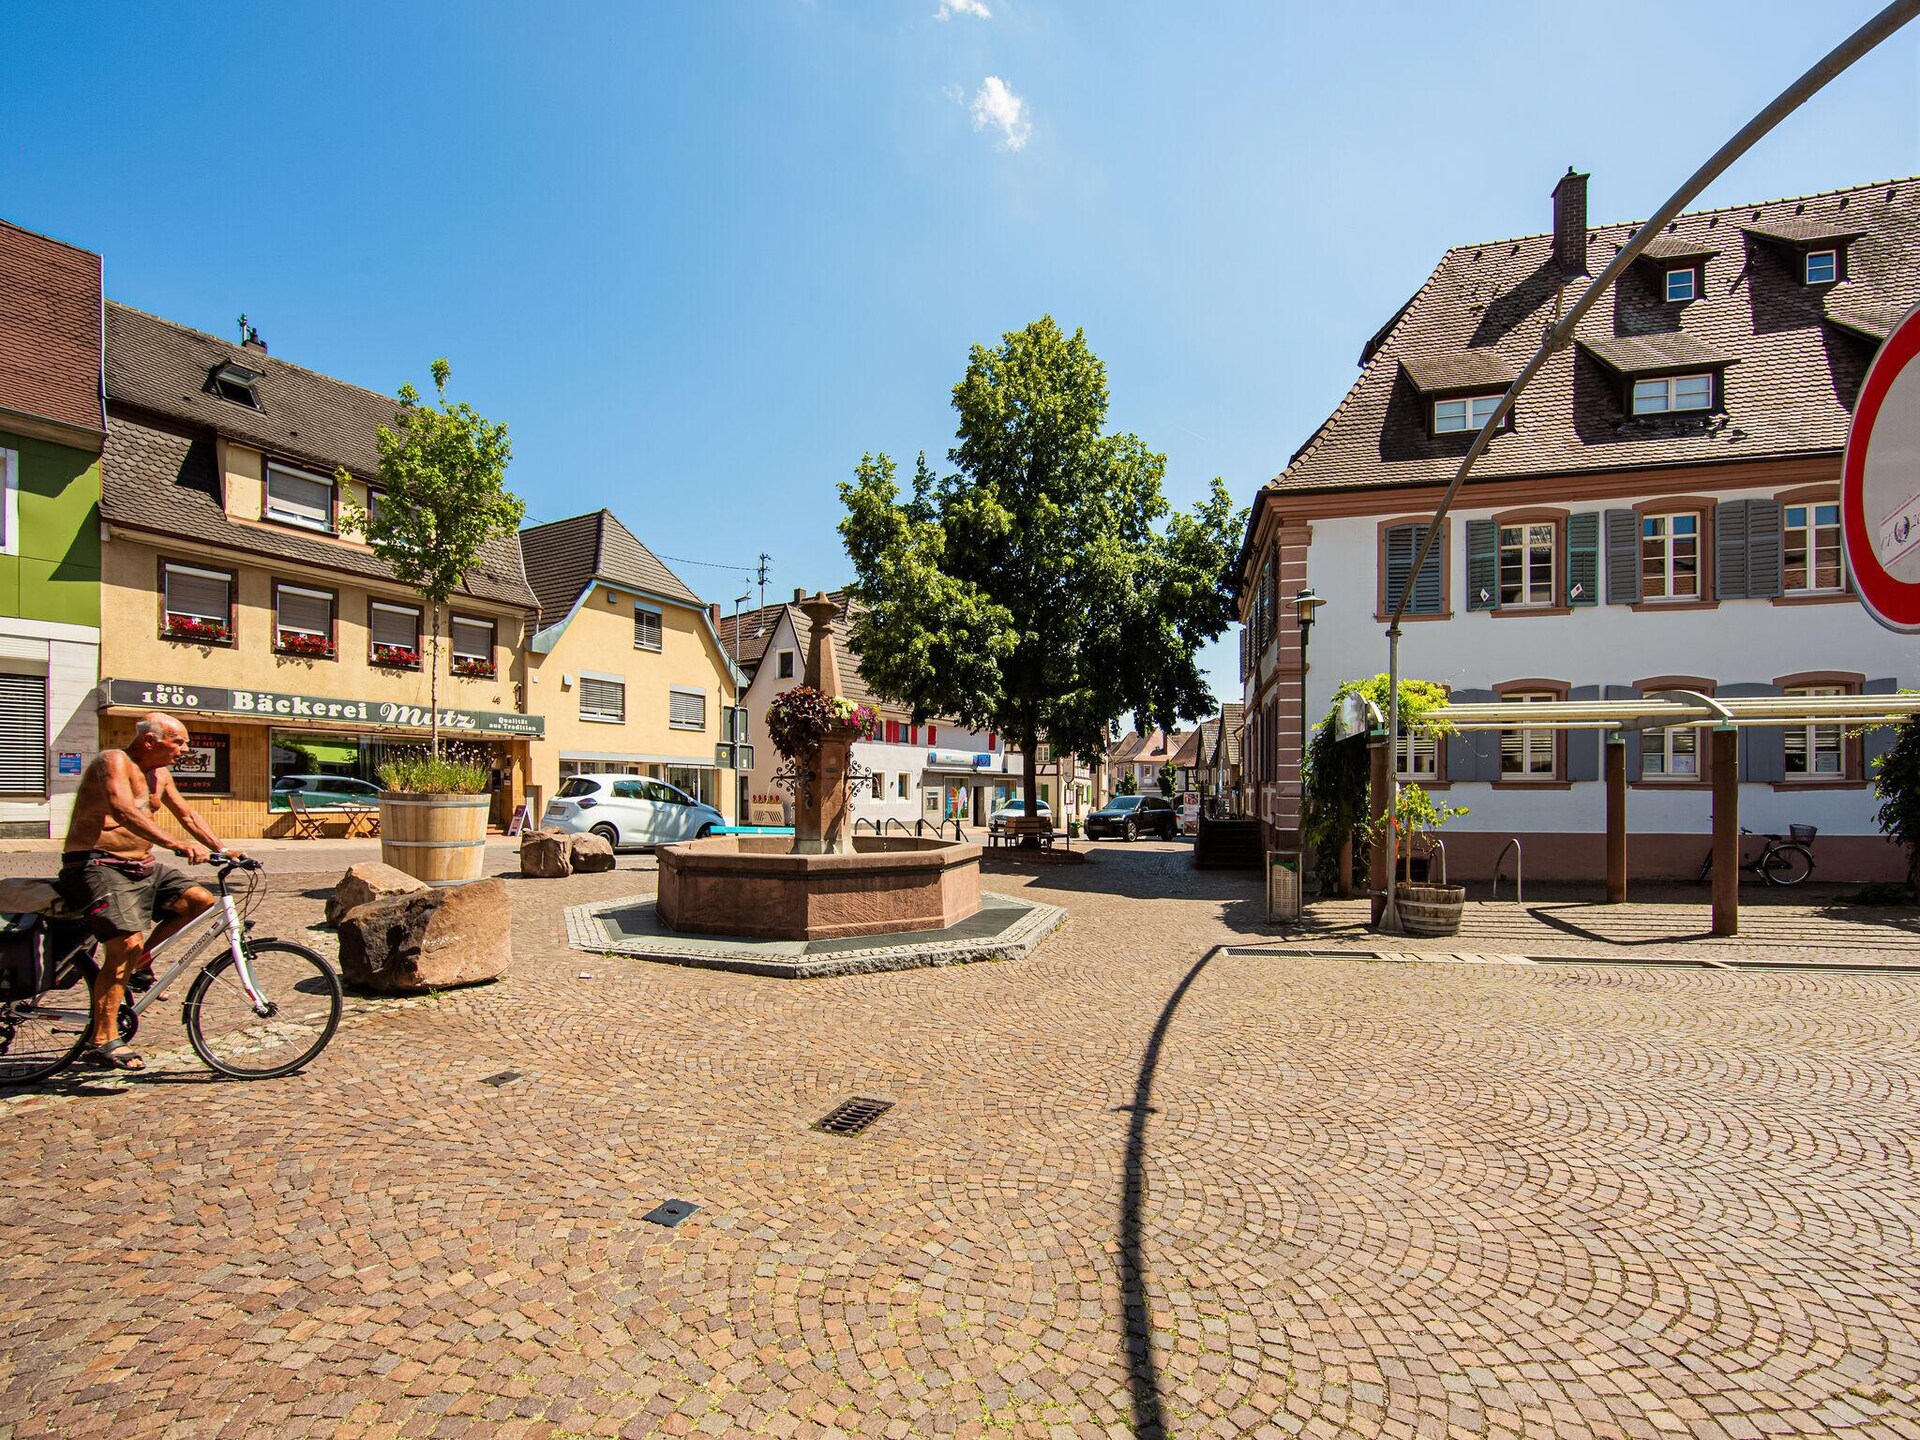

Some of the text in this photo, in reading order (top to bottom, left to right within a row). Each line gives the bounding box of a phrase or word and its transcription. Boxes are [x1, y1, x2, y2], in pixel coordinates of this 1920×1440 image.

[156, 684, 184, 693] Seit
[142, 691, 198, 706] 1800
[233, 691, 475, 728] Bäckerei Mutz
[498, 716, 528, 725] Qualität
[503, 723, 537, 731] Tradition
[177, 930, 211, 966] MORRISON
